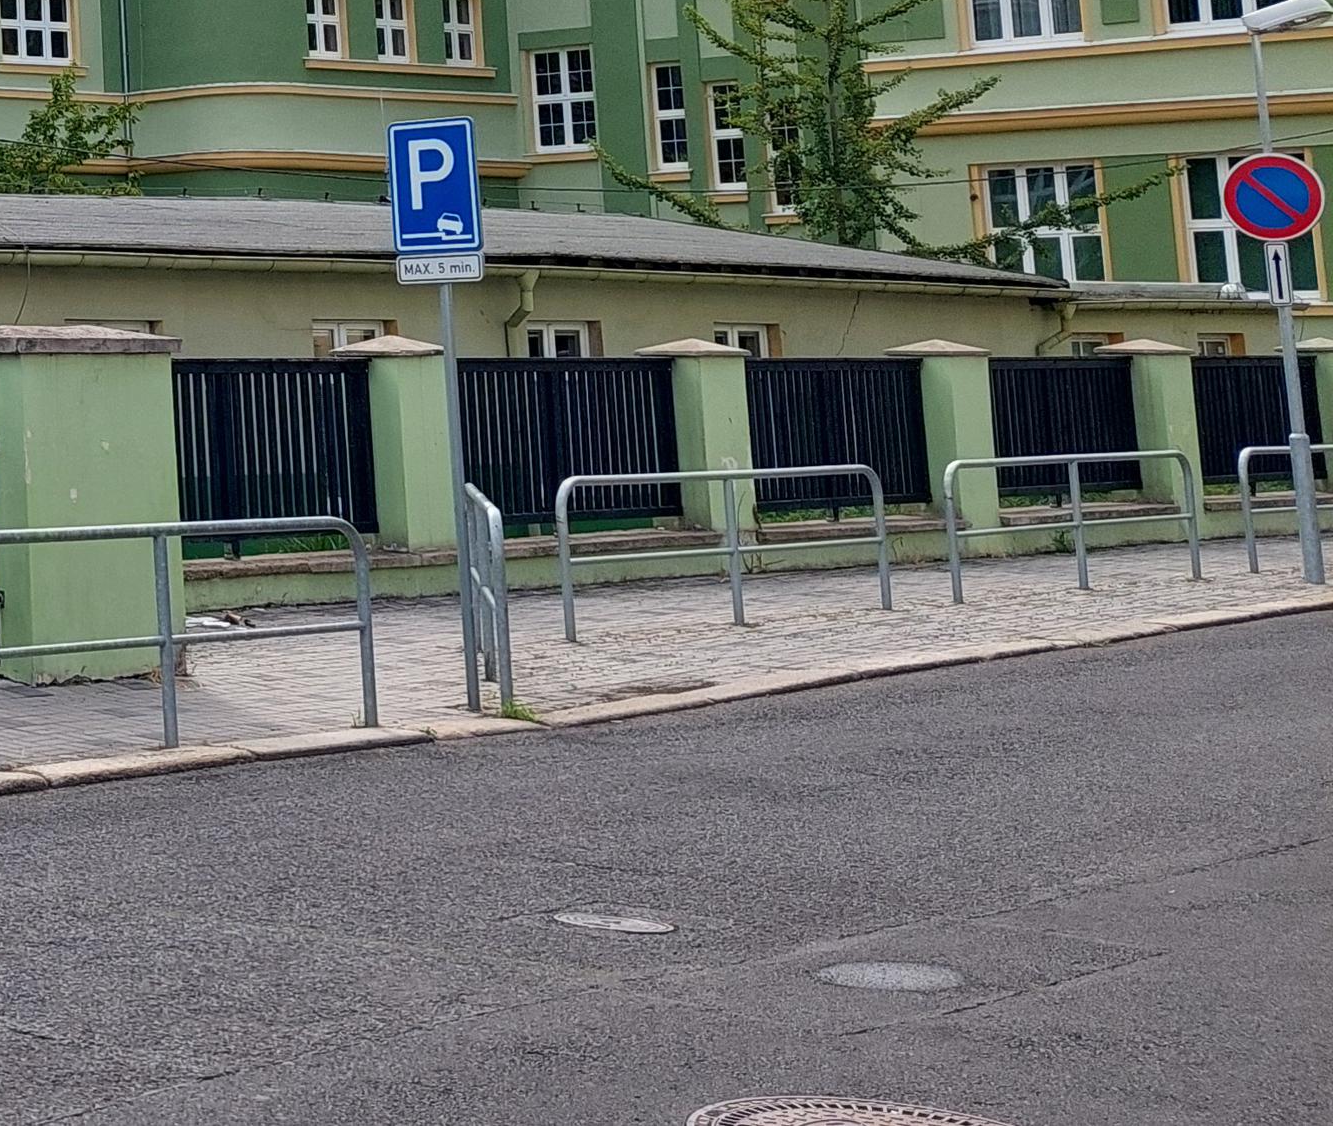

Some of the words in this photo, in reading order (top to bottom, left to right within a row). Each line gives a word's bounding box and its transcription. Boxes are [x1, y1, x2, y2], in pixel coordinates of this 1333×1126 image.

[408, 138, 455, 210] P
[404, 262, 434, 275] MAX.
[438, 262, 446, 274] 5
[450, 261, 475, 273] min.
